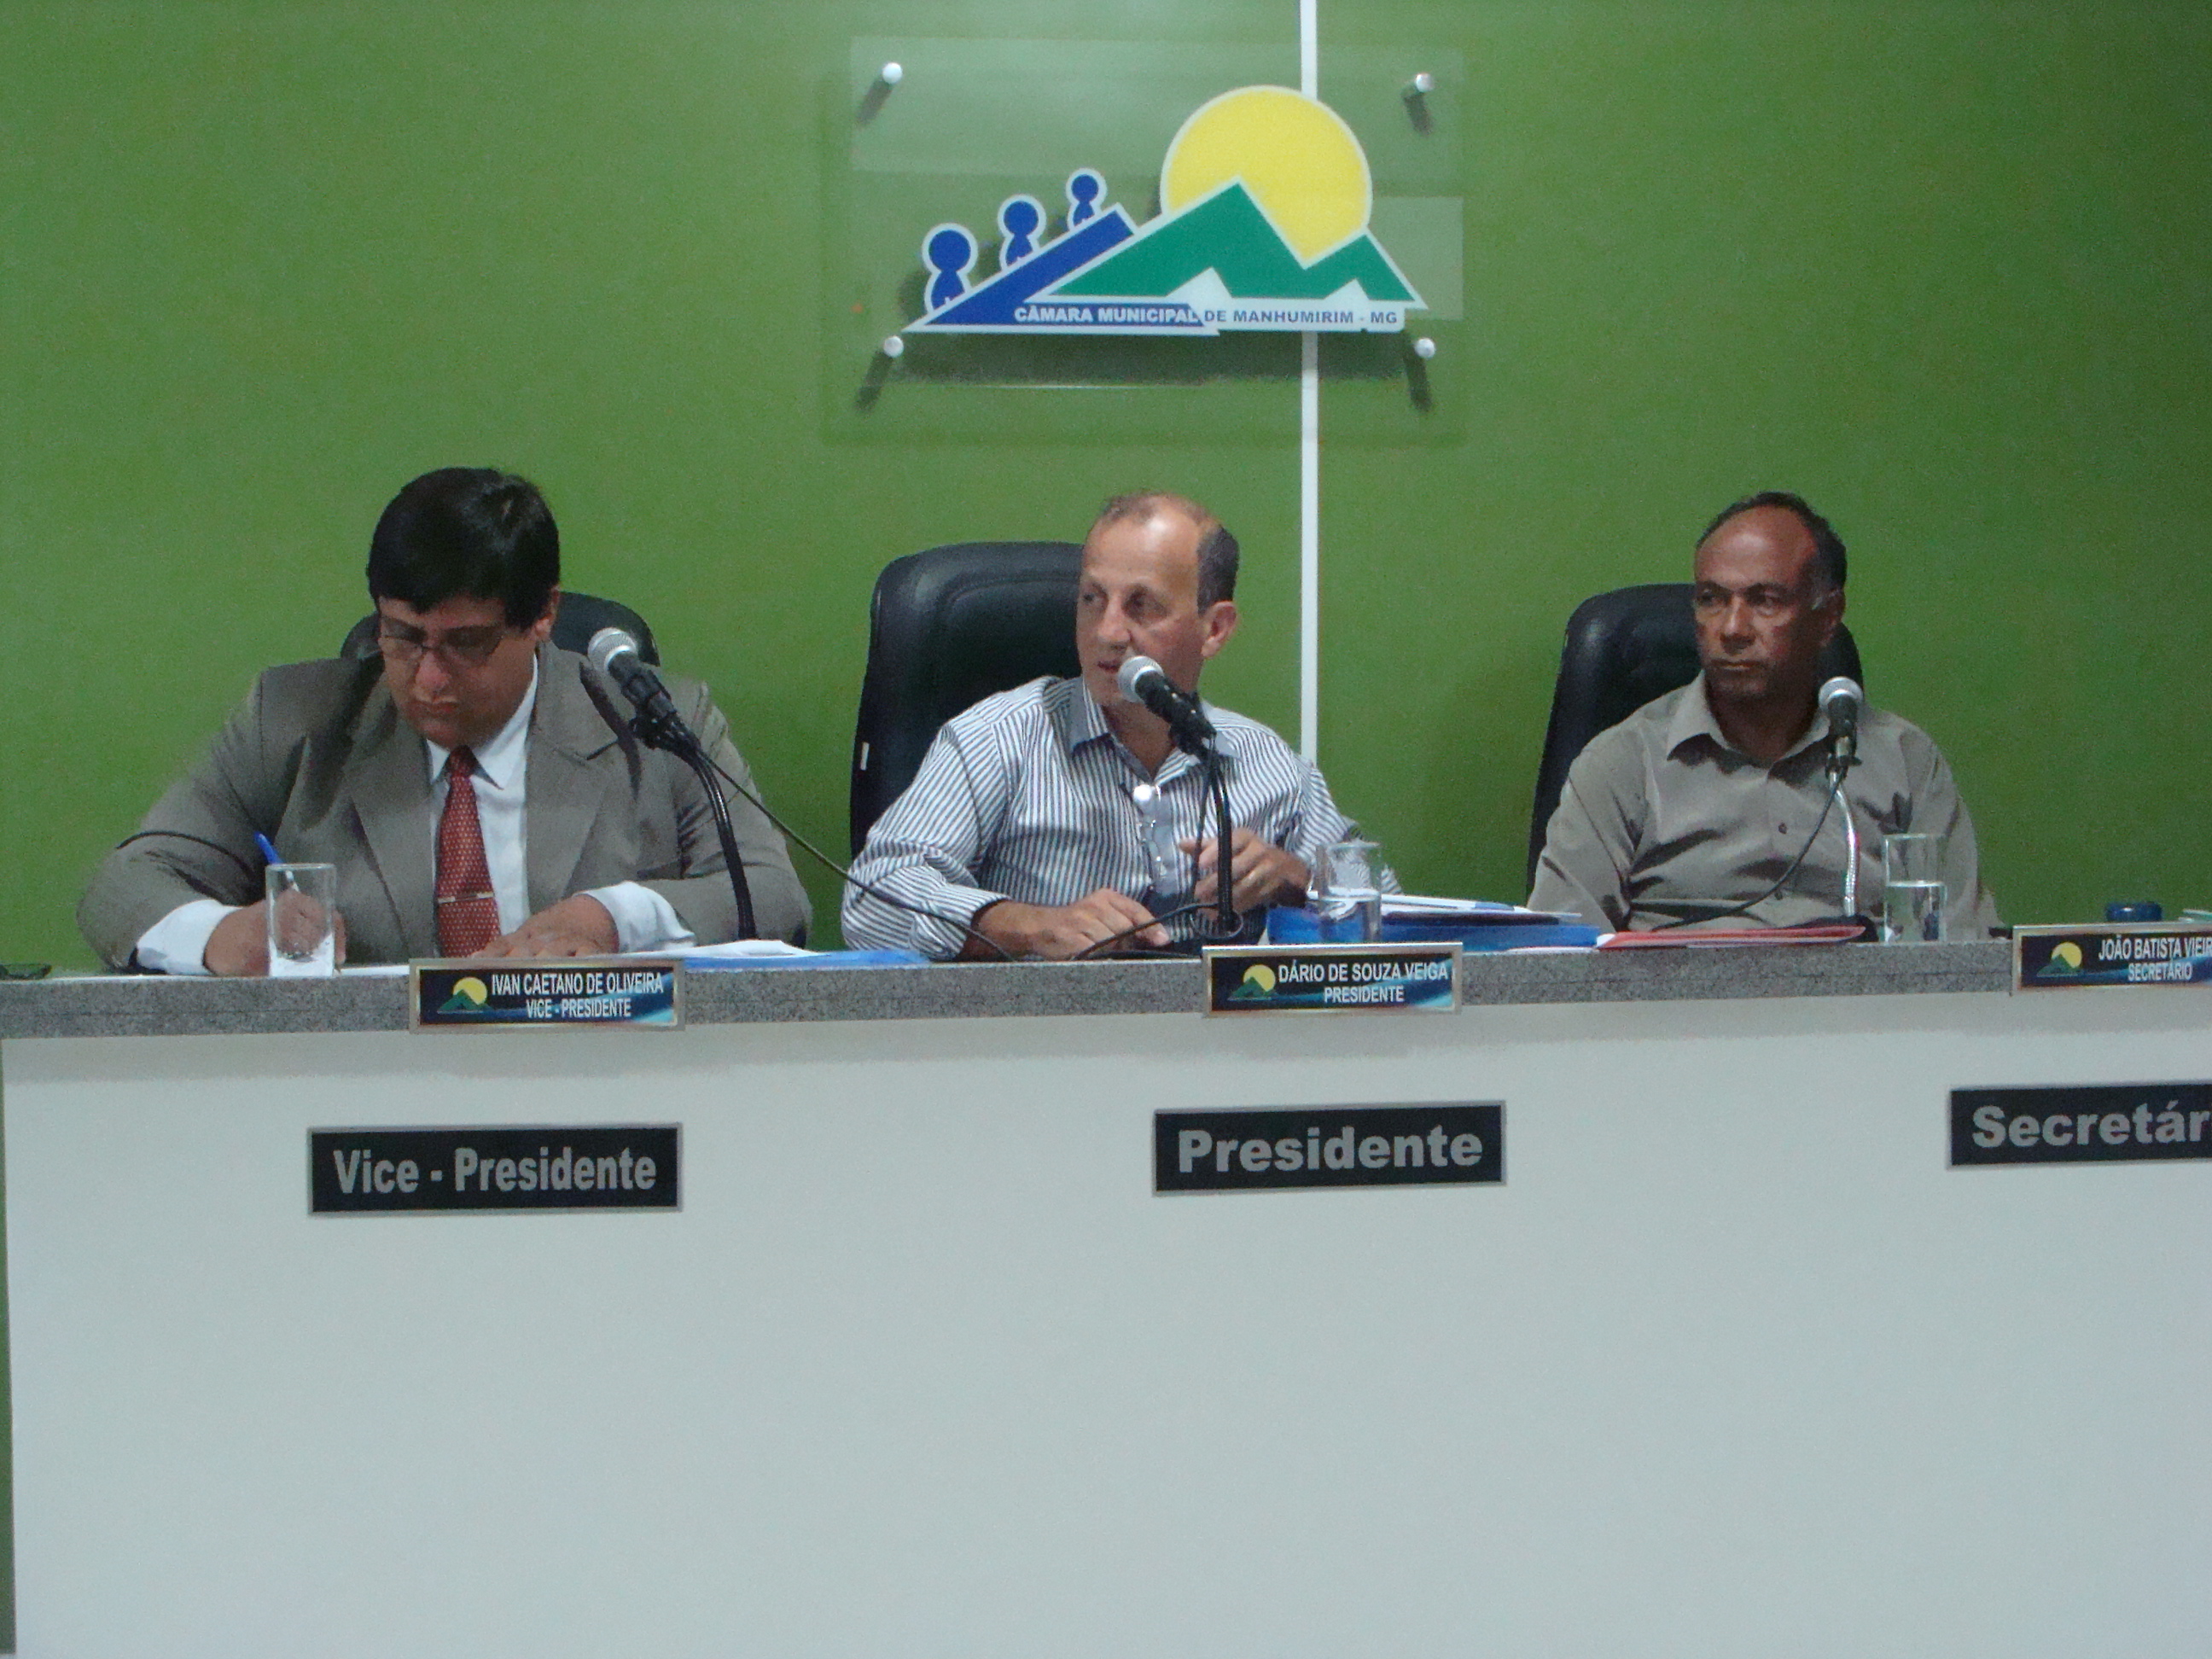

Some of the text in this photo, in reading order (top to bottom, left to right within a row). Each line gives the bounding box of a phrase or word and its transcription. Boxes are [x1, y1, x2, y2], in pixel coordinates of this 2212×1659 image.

[1014, 306, 1093, 323] CÂMARA
[1097, 307, 1199, 323] MUNICIPAL
[1204, 310, 1226, 322] DE
[1233, 310, 1353, 323] MANHUMIRIM
[1371, 311, 1398, 323] MG
[2098, 934, 2132, 960] JOÃO
[2134, 938, 2181, 959] BATISTA
[1278, 959, 1448, 983] DÁRIO DE SOUZA VEIGA
[2128, 959, 2192, 981] SECRETÁRIO
[492, 972, 664, 996] IVAN CAETANO DE OLIVEIRA
[1324, 986, 1404, 1004] PRESIDENTE
[526, 999, 552, 1018] VICE
[562, 998, 632, 1017] PRESIDENTE
[1972, 1100, 2210, 1148] Secretár
[1179, 1125, 1483, 1173] Presidente
[333, 1149, 420, 1193] Vice
[455, 1146, 657, 1191] Presidente
